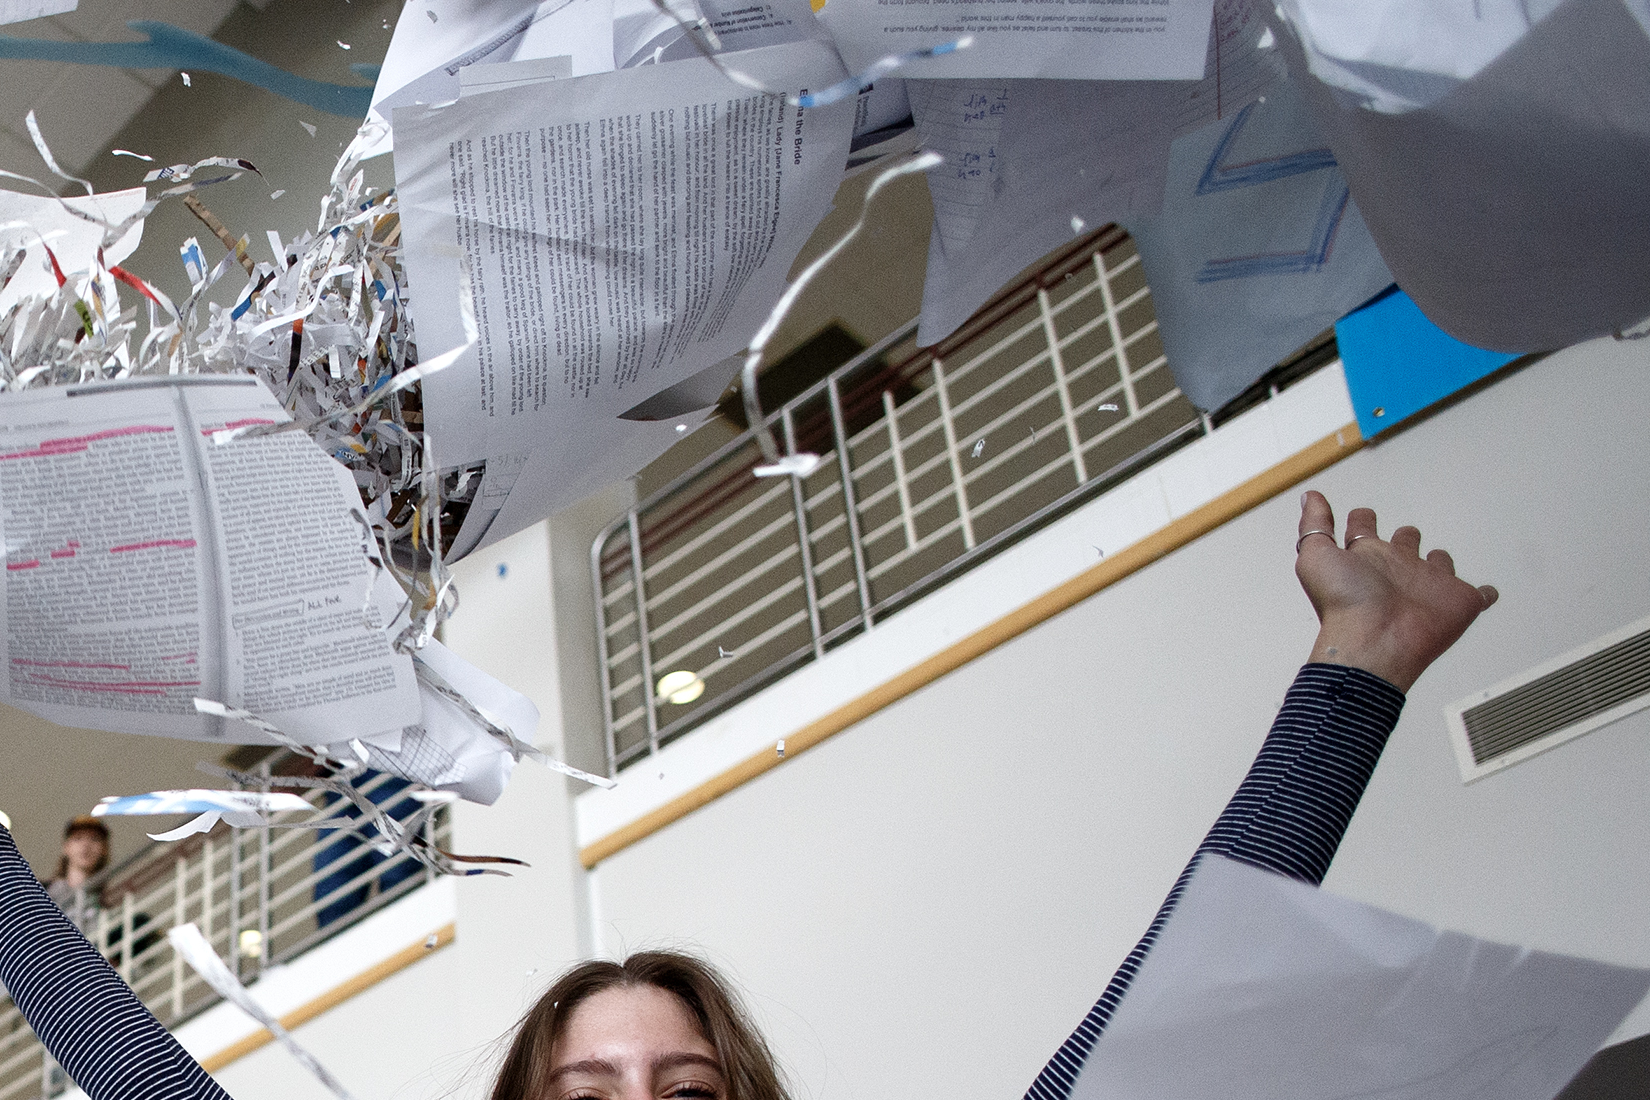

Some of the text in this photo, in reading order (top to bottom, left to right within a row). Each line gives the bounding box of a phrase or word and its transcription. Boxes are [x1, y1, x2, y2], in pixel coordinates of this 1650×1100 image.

[736, 15, 766, 23] Conservation
[650, 111, 658, 140] suddenly
[775, 126, 783, 145] Lady
[794, 88, 807, 165] Ena the Bride
[481, 136, 489, 162] reached
[617, 142, 625, 164] longed
[658, 127, 666, 159] gossamer
[659, 160, 667, 185] clasped
[683, 105, 692, 274] nothing dancing feasting hunting
[500, 168, 508, 193] window
[505, 239, 513, 255] night
[527, 192, 536, 220] mounted
[538, 127, 546, 153] purpose
[549, 268, 557, 285] could
[627, 155, 638, 310] declared passed night beautiful
[467, 171, 476, 197] stopped
[481, 305, 489, 324] heard
[661, 238, 669, 256] bright
[707, 240, 715, 263] country
[492, 170, 501, 199] dreamed
[499, 253, 507, 275] himself
[507, 339, 516, 365] galloped
[568, 188, 576, 208] young
[578, 310, 586, 341] household
[533, 285, 544, 312] galloped
[557, 267, 566, 304] messengers
[537, 312, 546, 326] right
[585, 306, 593, 327] looked
[477, 357, 485, 377] palace
